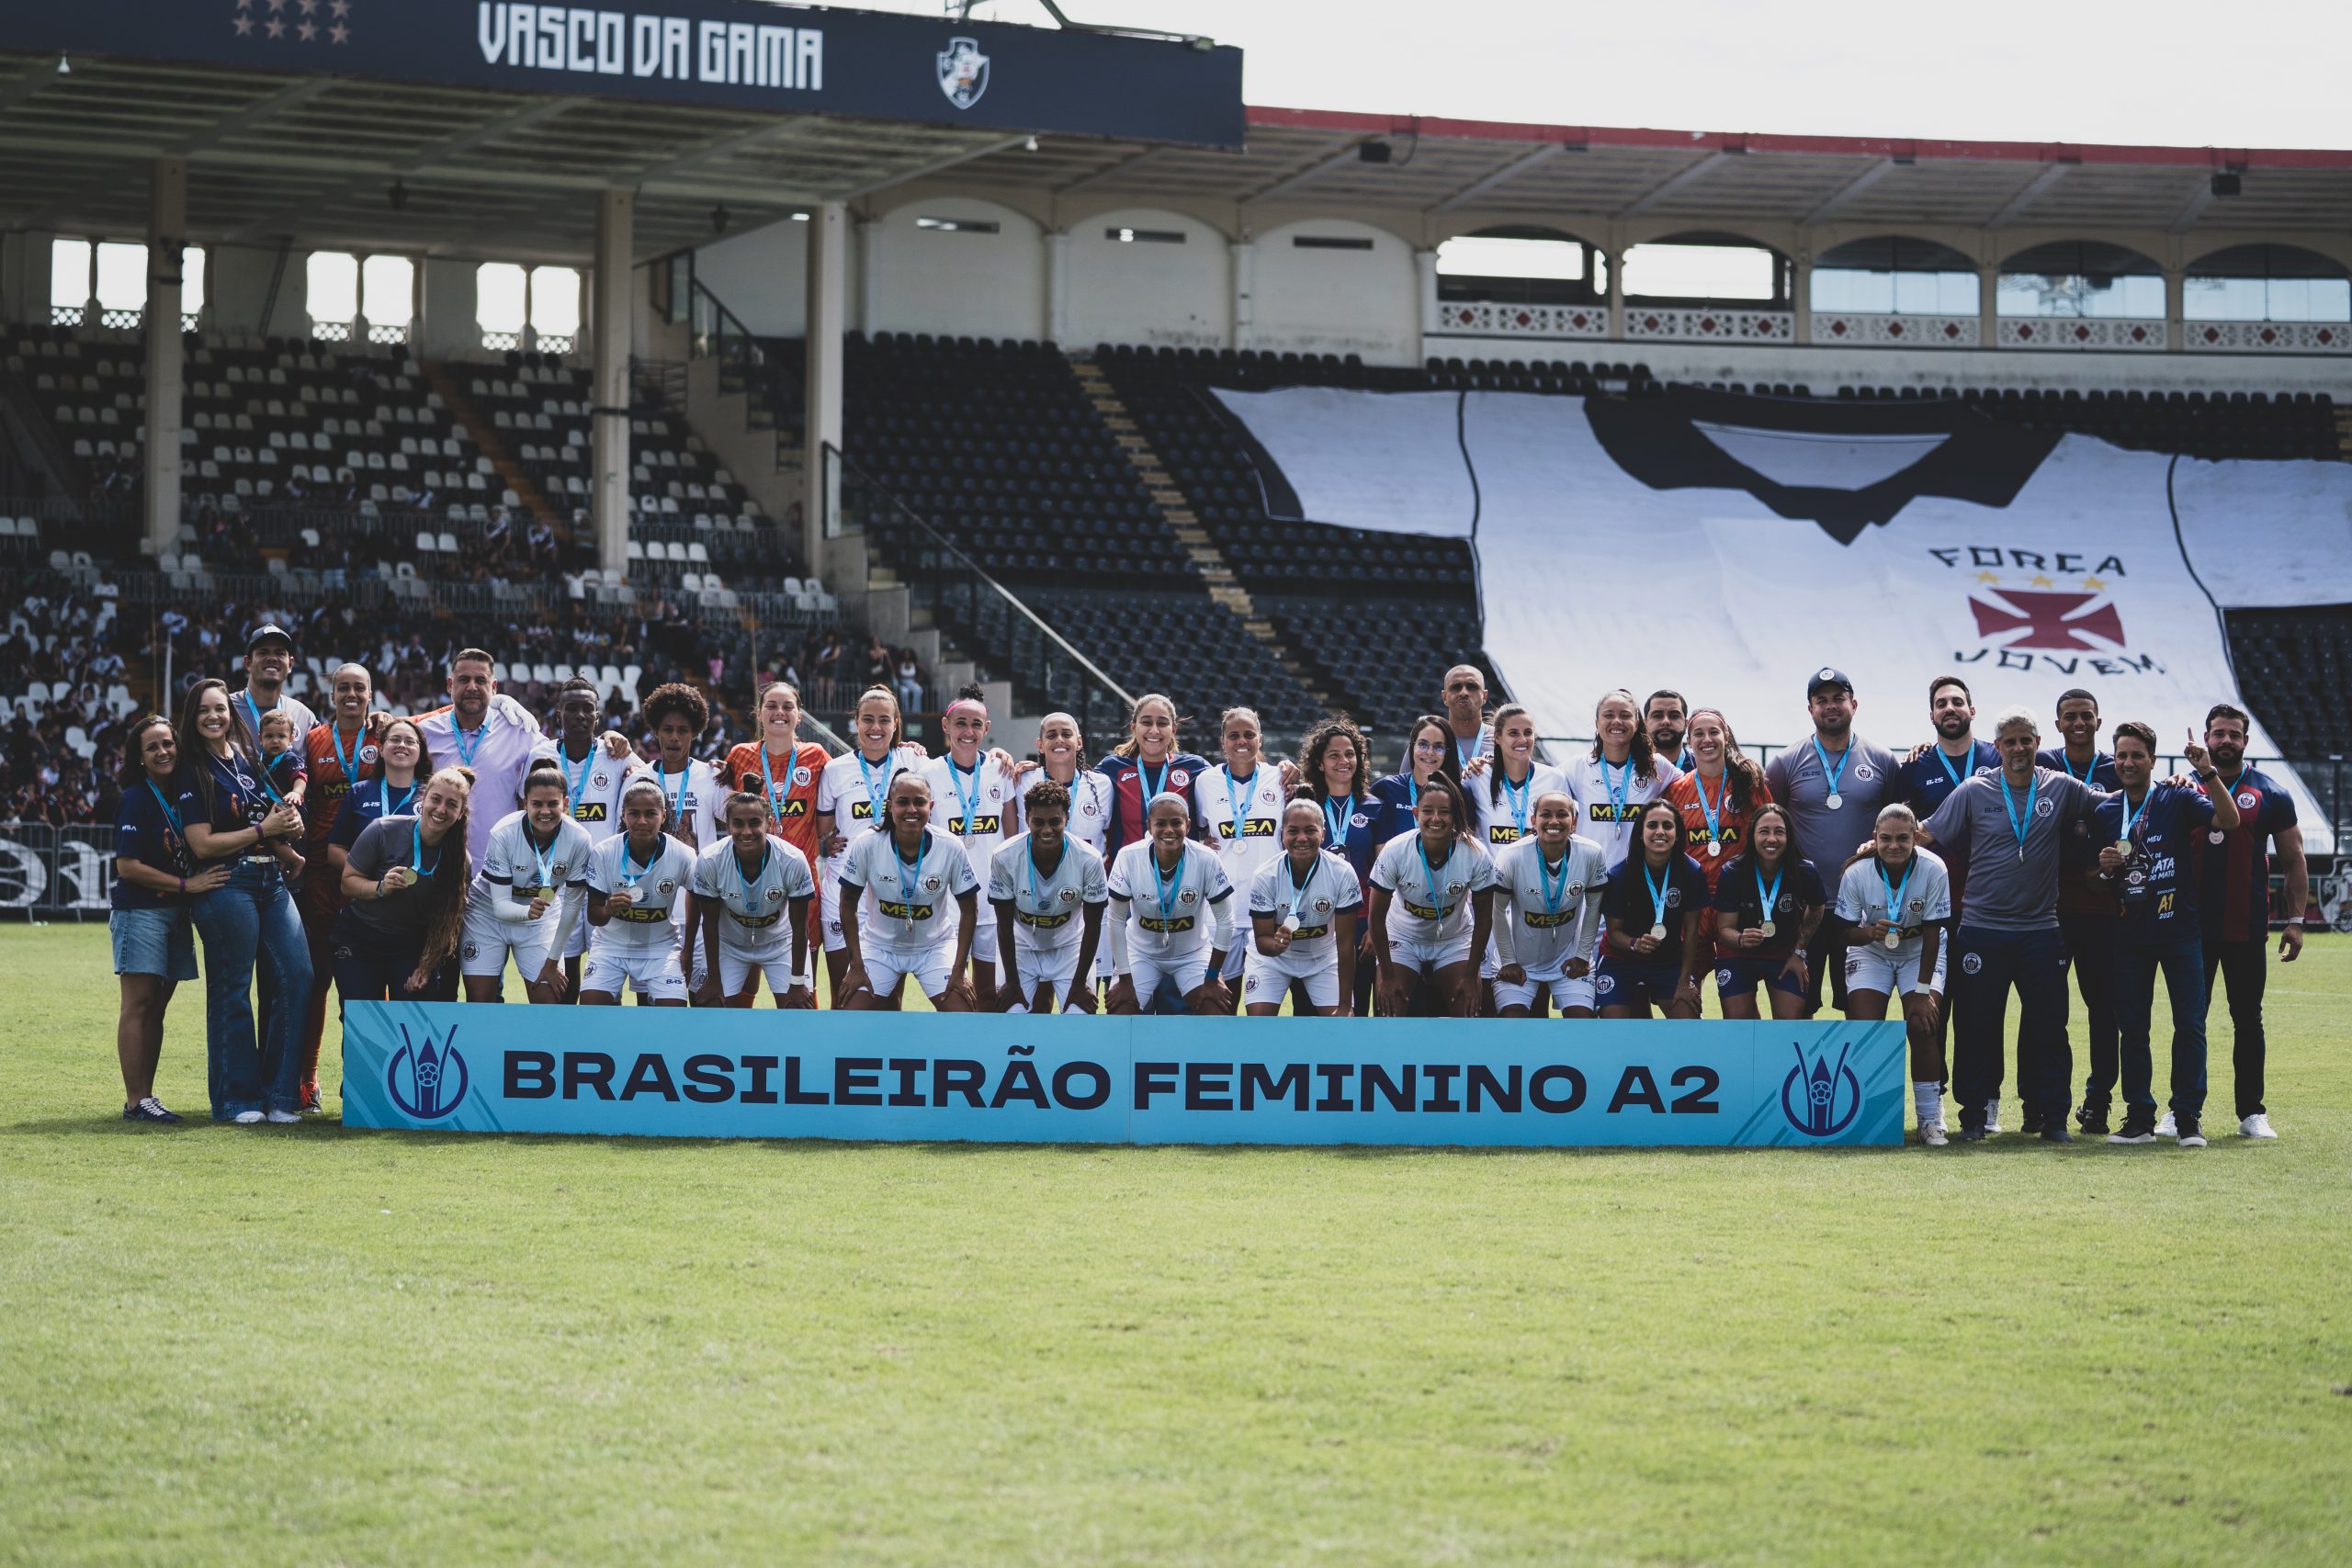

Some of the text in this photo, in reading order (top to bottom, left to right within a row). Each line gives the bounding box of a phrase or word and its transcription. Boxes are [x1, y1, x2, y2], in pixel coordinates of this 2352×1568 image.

[479, 1, 823, 91] VASCO DA GAMA
[1955, 649, 2165, 675] JOVEM
[1926, 777, 1944, 785] BRS
[323, 783, 350, 795] MS
[778, 801, 804, 813] SA
[950, 817, 997, 832] MSA
[1220, 820, 1273, 836] MSA
[1491, 828, 1521, 840] MS
[1689, 828, 1737, 842] MSA
[2146, 834, 2163, 844] MEU
[2151, 857, 2176, 874] ATA
[2157, 869, 2176, 880] MATO
[881, 902, 931, 918] MSA
[1405, 902, 1453, 919] MSA
[2157, 893, 2175, 914] A1
[617, 908, 666, 920] MSA
[1020, 913, 1069, 927] MSA
[1526, 910, 1574, 925] MSA
[2159, 910, 2175, 919] 2027
[1140, 918, 1191, 930] MSA
[1293, 927, 1325, 937] SA
[503, 1044, 1720, 1114] BRASILEIRÃO FEMININO A2
